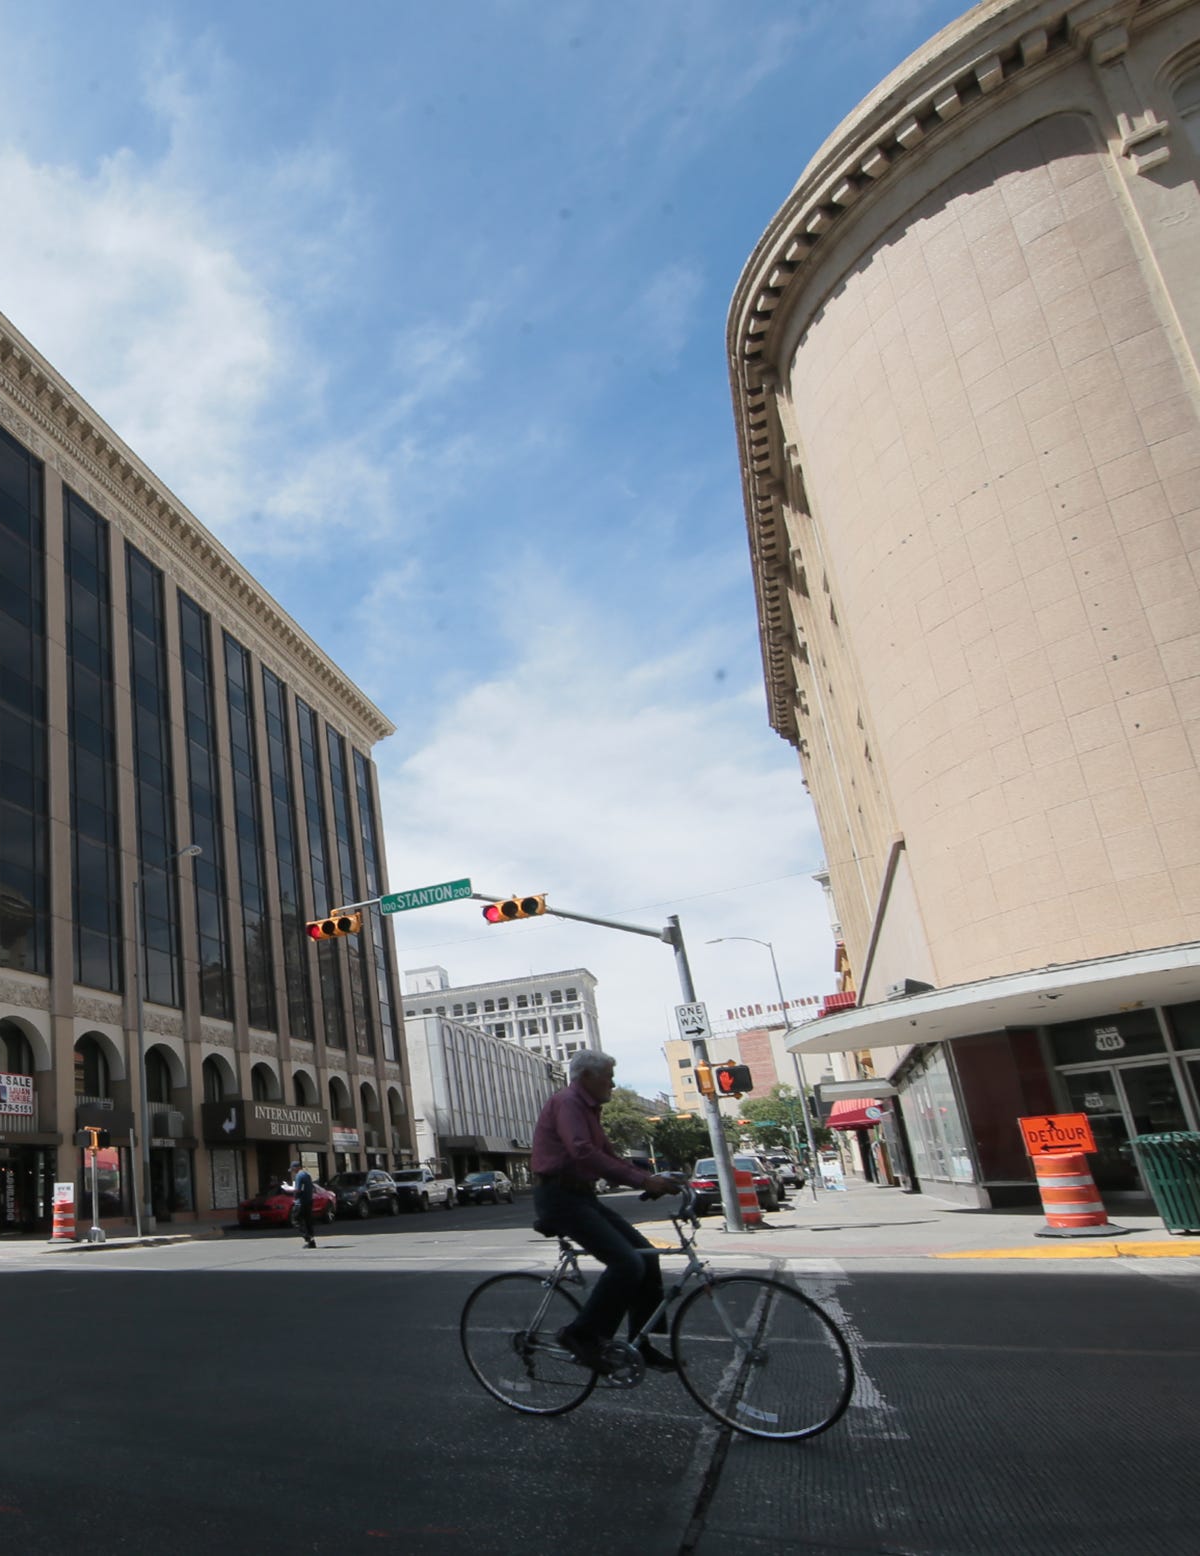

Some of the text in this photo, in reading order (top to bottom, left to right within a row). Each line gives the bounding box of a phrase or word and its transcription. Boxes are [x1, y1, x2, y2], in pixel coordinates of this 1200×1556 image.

[383, 885, 471, 913] 100 STANTON 200
[679, 1005, 703, 1017] ONE
[680, 1015, 706, 1027] WAY
[1099, 1035, 1121, 1049] 101
[5, 1076, 32, 1088] SALE
[255, 1105, 323, 1125] INTERNATIONAL
[270, 1121, 312, 1138] BUILDING
[1029, 1127, 1087, 1144] DETOUR
